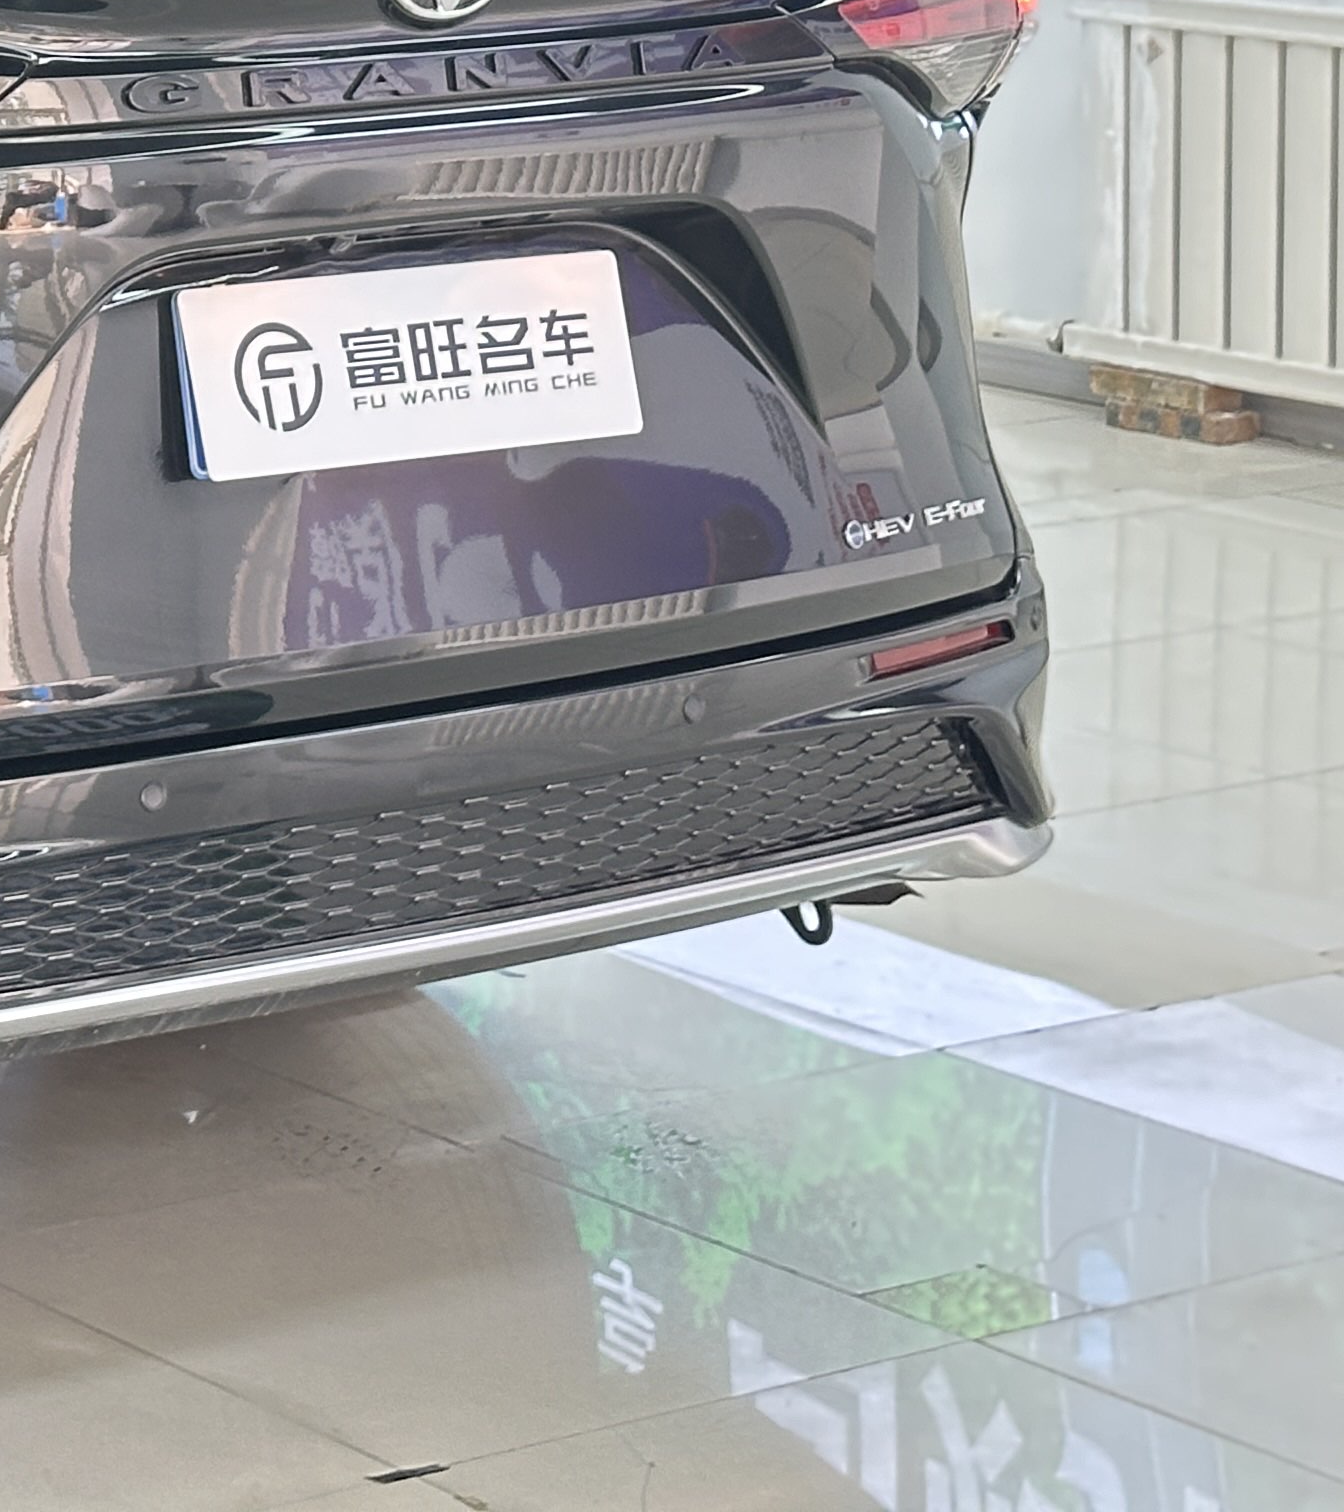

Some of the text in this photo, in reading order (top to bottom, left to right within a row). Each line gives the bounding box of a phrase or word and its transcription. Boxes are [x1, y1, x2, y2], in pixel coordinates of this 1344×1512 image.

[120, 33, 745, 114] GRANVIA
[339, 309, 595, 389] 富旺名车
[352, 371, 598, 411] FU WANG MING CHE
